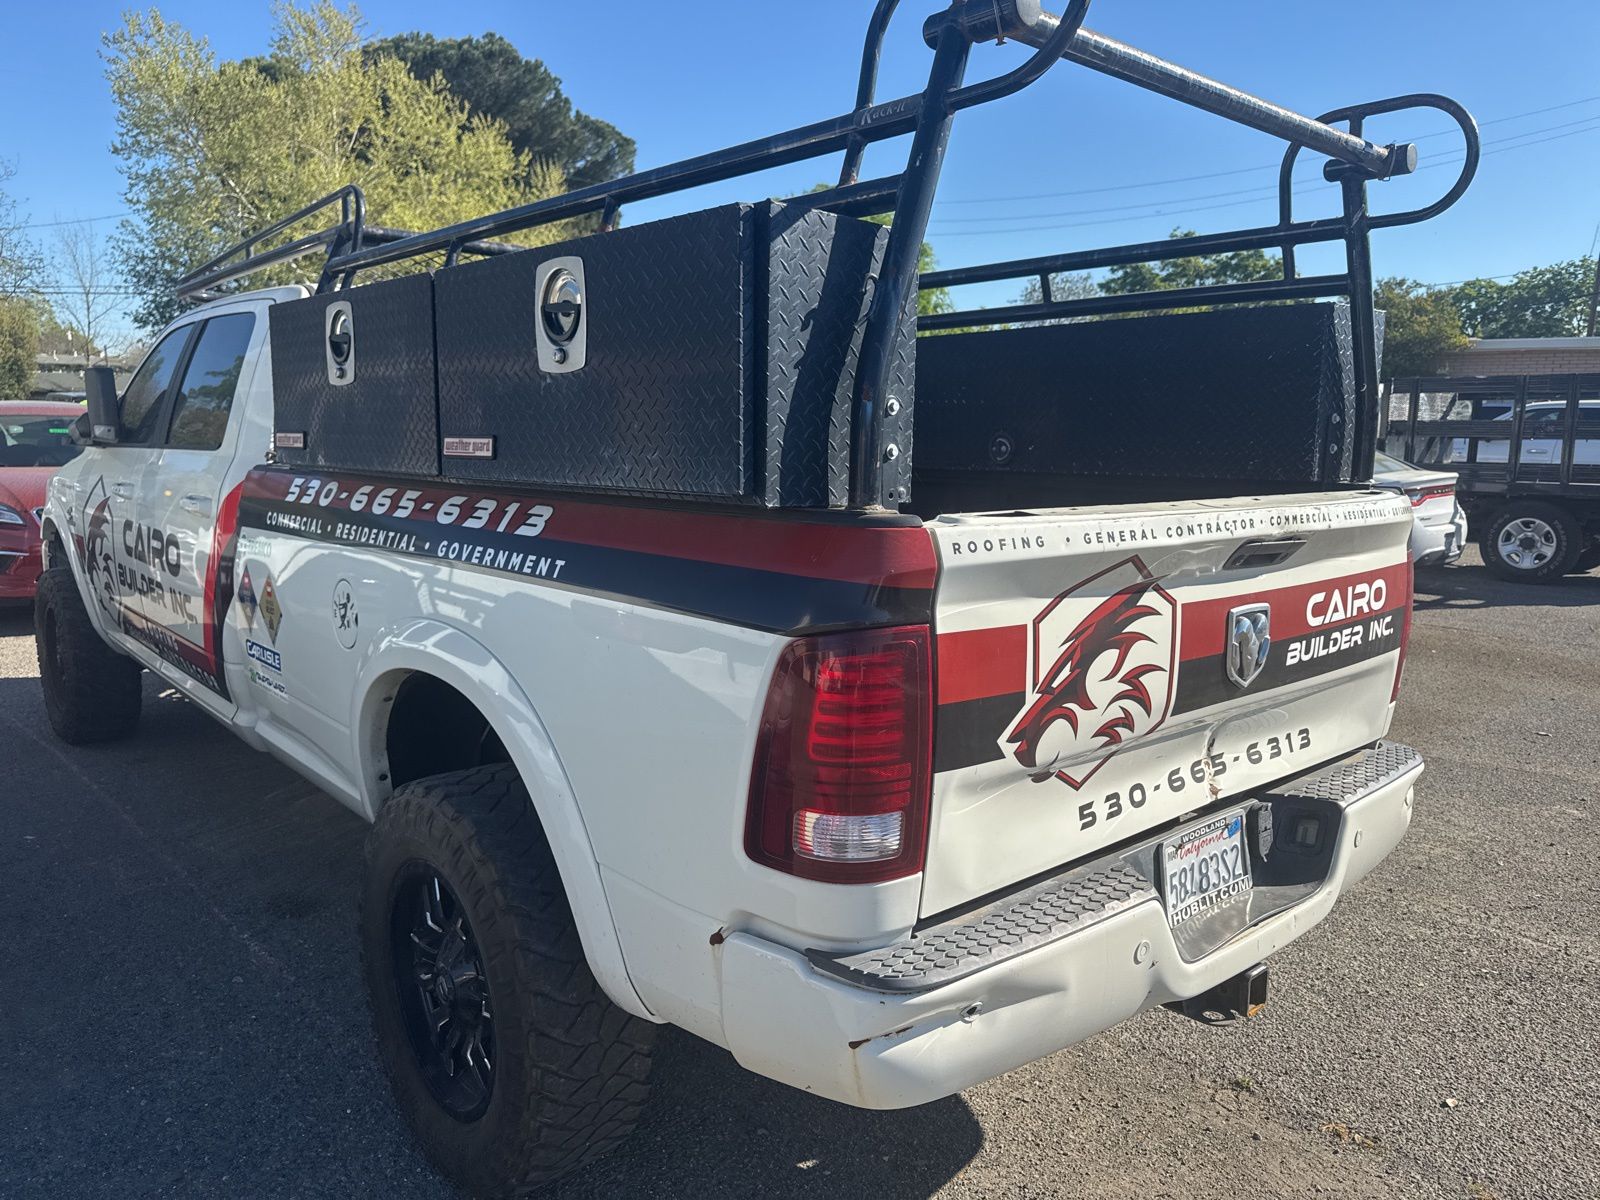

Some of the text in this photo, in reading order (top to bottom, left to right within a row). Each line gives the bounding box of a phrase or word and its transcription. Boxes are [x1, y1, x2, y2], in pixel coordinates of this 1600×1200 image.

[285, 477, 554, 537] 530-665-6313
[123, 519, 181, 577] CAIRO
[266, 511, 566, 579] COMMERCIAL RESIDENTIAL GOVERNMENT
[952, 535, 1045, 555] ROOFING
[1083, 527, 1158, 545] GENERAL
[1166, 518, 1255, 538] CONTRACTOR
[1269, 514, 1332, 527] COMMERCIAL
[1343, 510, 1386, 521] RESIDENTIAL
[117, 563, 167, 609] BUILDER
[1306, 578, 1387, 627] CAIRO
[247, 641, 280, 668] CARLISLE
[1285, 615, 1394, 667] BUILDER INC.
[1078, 727, 1312, 832] 530-665-6313
[1179, 831, 1228, 860] California
[1182, 819, 1226, 843] WOODLAND
[1169, 843, 1243, 911] 58183S2
[1172, 879, 1250, 926] HUBLIT.COM
